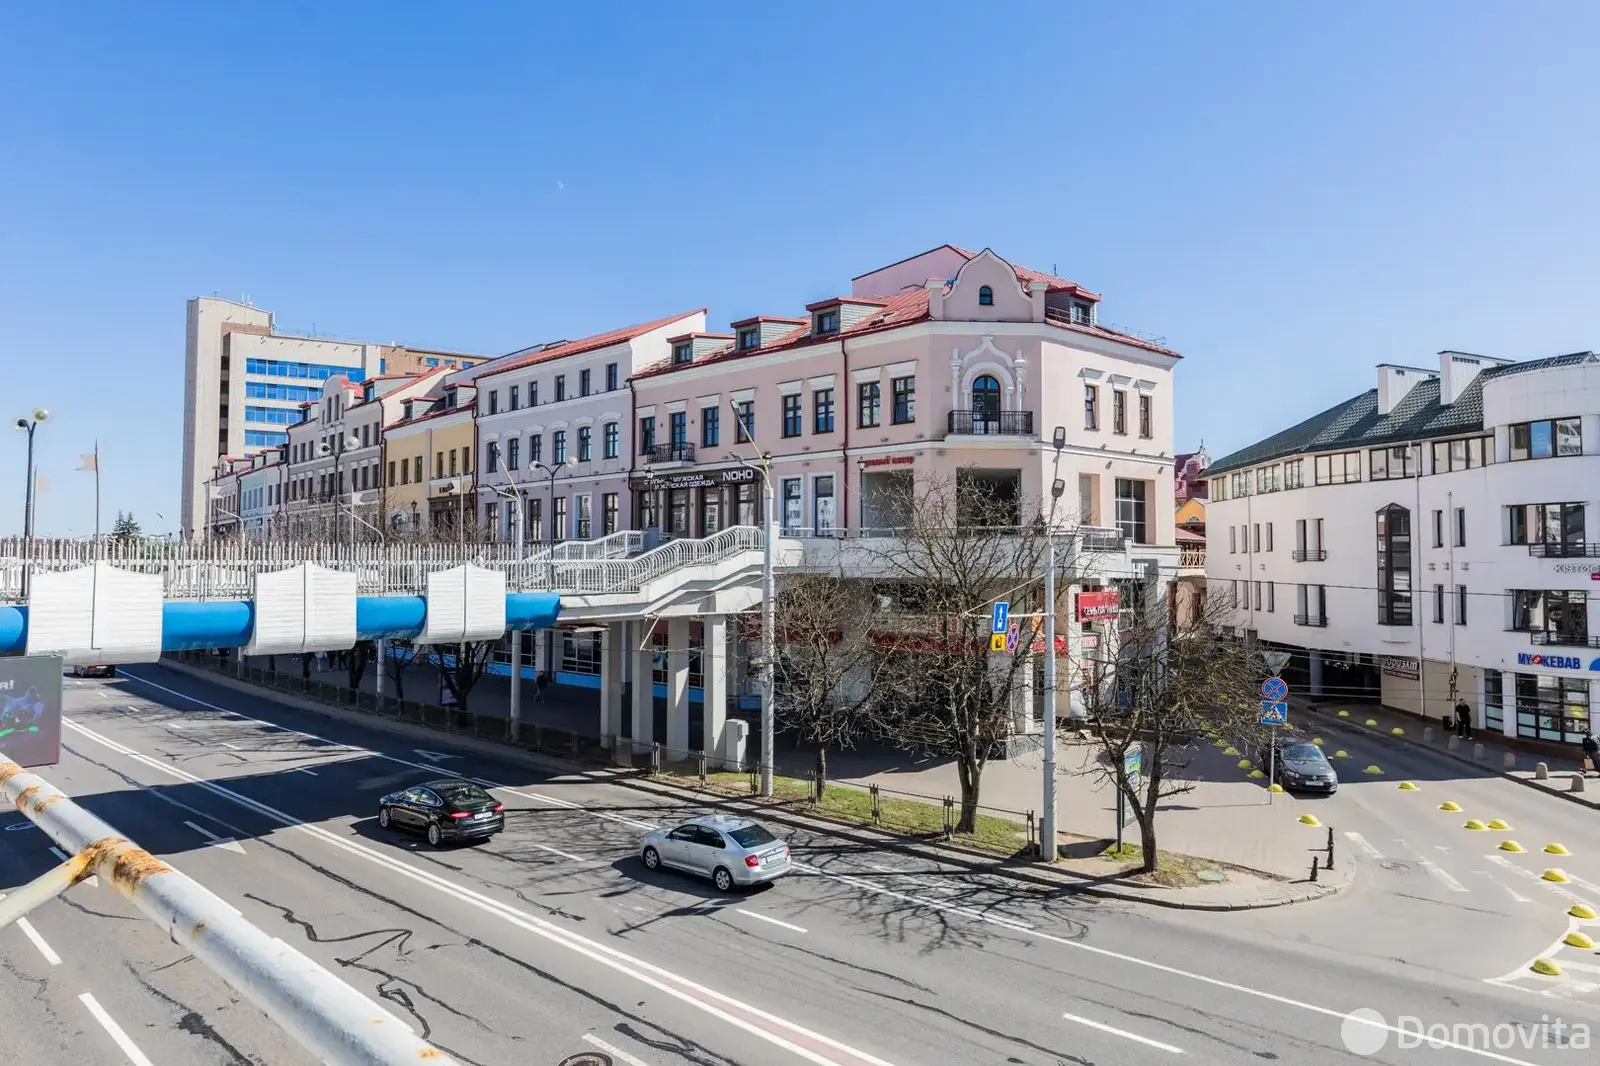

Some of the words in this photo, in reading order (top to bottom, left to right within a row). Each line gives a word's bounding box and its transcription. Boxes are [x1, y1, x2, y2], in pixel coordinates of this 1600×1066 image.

[722, 469, 754, 481] NOHO
[1518, 653, 1532, 665] MY
[1542, 655, 1581, 669] KEBAB
